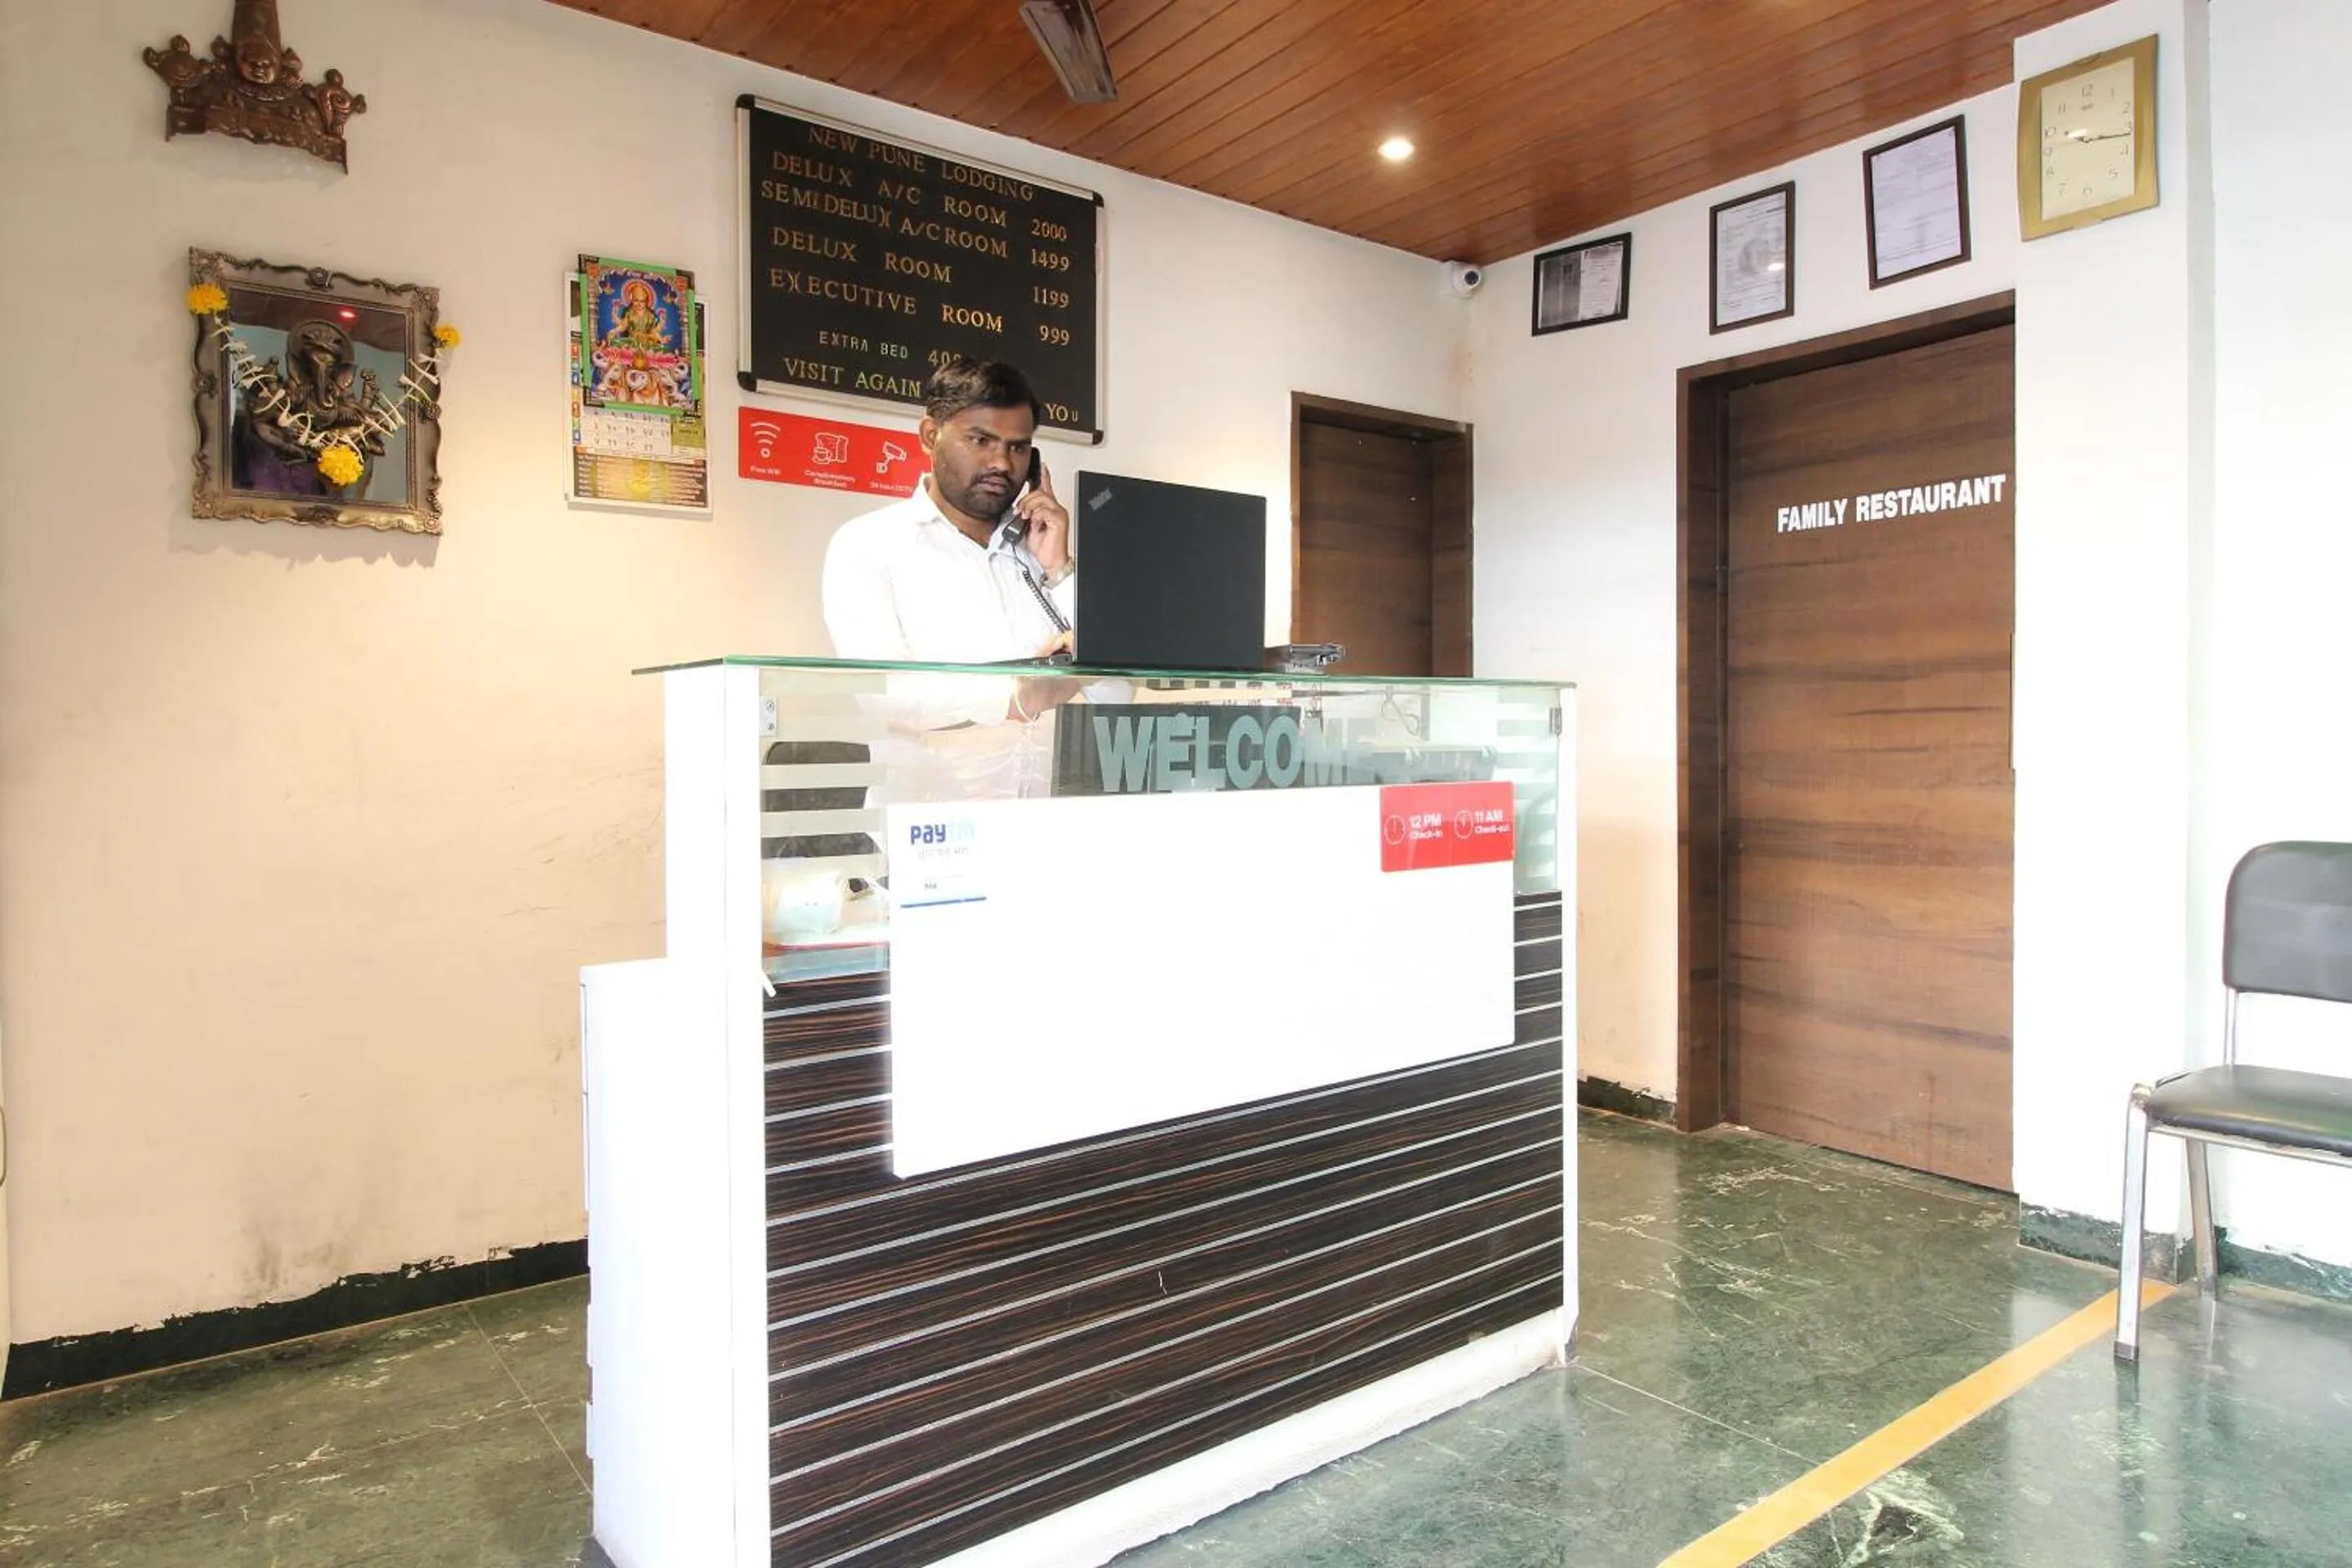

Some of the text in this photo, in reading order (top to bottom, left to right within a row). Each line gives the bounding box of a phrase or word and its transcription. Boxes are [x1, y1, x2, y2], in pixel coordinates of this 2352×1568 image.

[808, 127, 1035, 201] NEW PUNE LODGING
[772, 150, 1068, 243] DELUX A/C ROOM 2000
[773, 226, 1069, 308] DELUX ROOM 1199
[1031, 248, 1070, 272] 1499
[768, 268, 1070, 345] EXECUTIVE ROOM 999
[819, 331, 868, 352] EXTRA
[880, 342, 909, 359] BED
[782, 357, 844, 385] VISIT
[855, 371, 921, 399] AGAIN
[1778, 473, 2007, 533] FAMILY RESTAURANT
[1423, 813, 1442, 827] PM
[1486, 808, 1503, 822] AM
